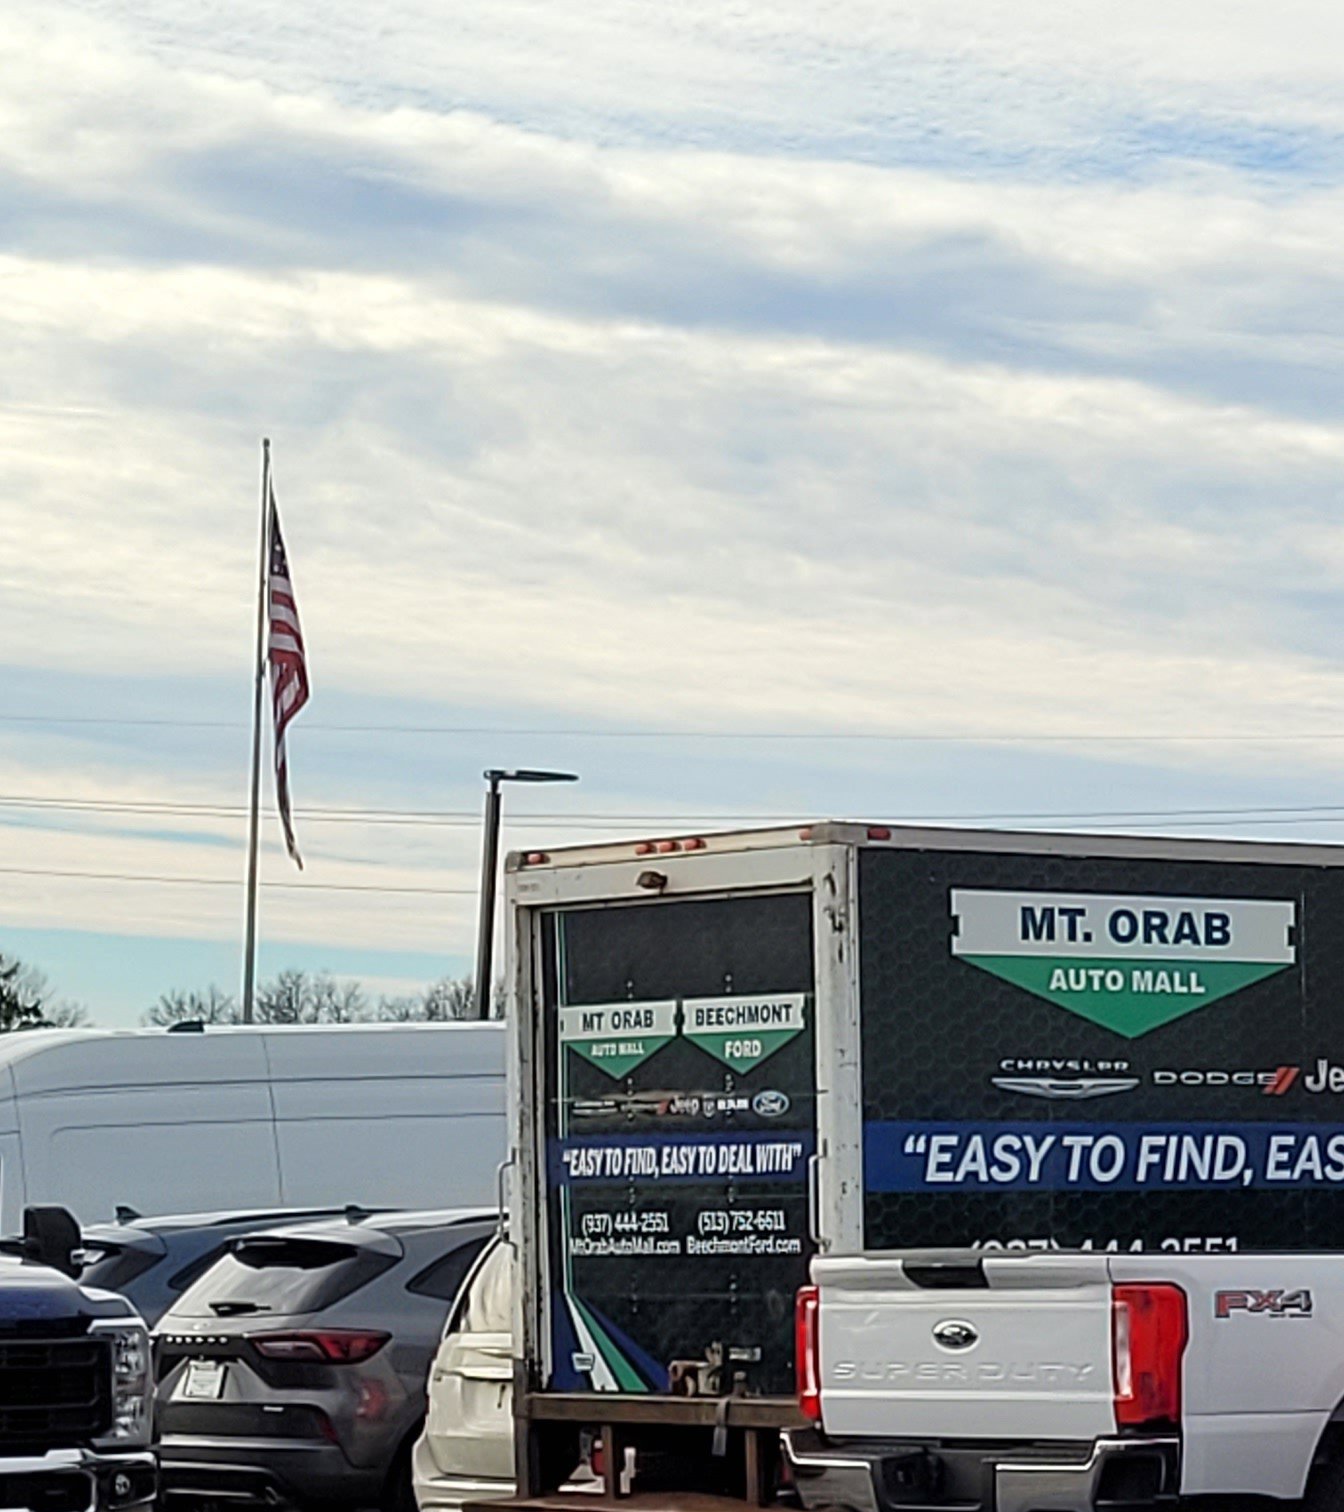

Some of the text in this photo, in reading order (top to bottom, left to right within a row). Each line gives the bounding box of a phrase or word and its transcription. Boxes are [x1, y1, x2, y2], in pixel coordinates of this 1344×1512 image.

[1019, 906, 1232, 948] MT. ORAB
[1050, 968, 1206, 995] AUTO MALL
[612, 1009, 654, 1030] ORAB
[695, 1003, 794, 1027] BEECHMONT
[591, 1043, 617, 1057] AUTO
[725, 1039, 762, 1058] FORD
[1153, 1070, 1278, 1086] DODGE
[604, 1148, 622, 1177] TO
[661, 1146, 696, 1175] EASY
[699, 1146, 716, 1174] TO
[718, 1145, 753, 1174] DEAL
[1062, 1134, 1126, 1183] TO
[1136, 1134, 1254, 1187] FIND,
[1215, 1290, 1313, 1318] FX4
[832, 1361, 1094, 1382] SUPER DUTY
